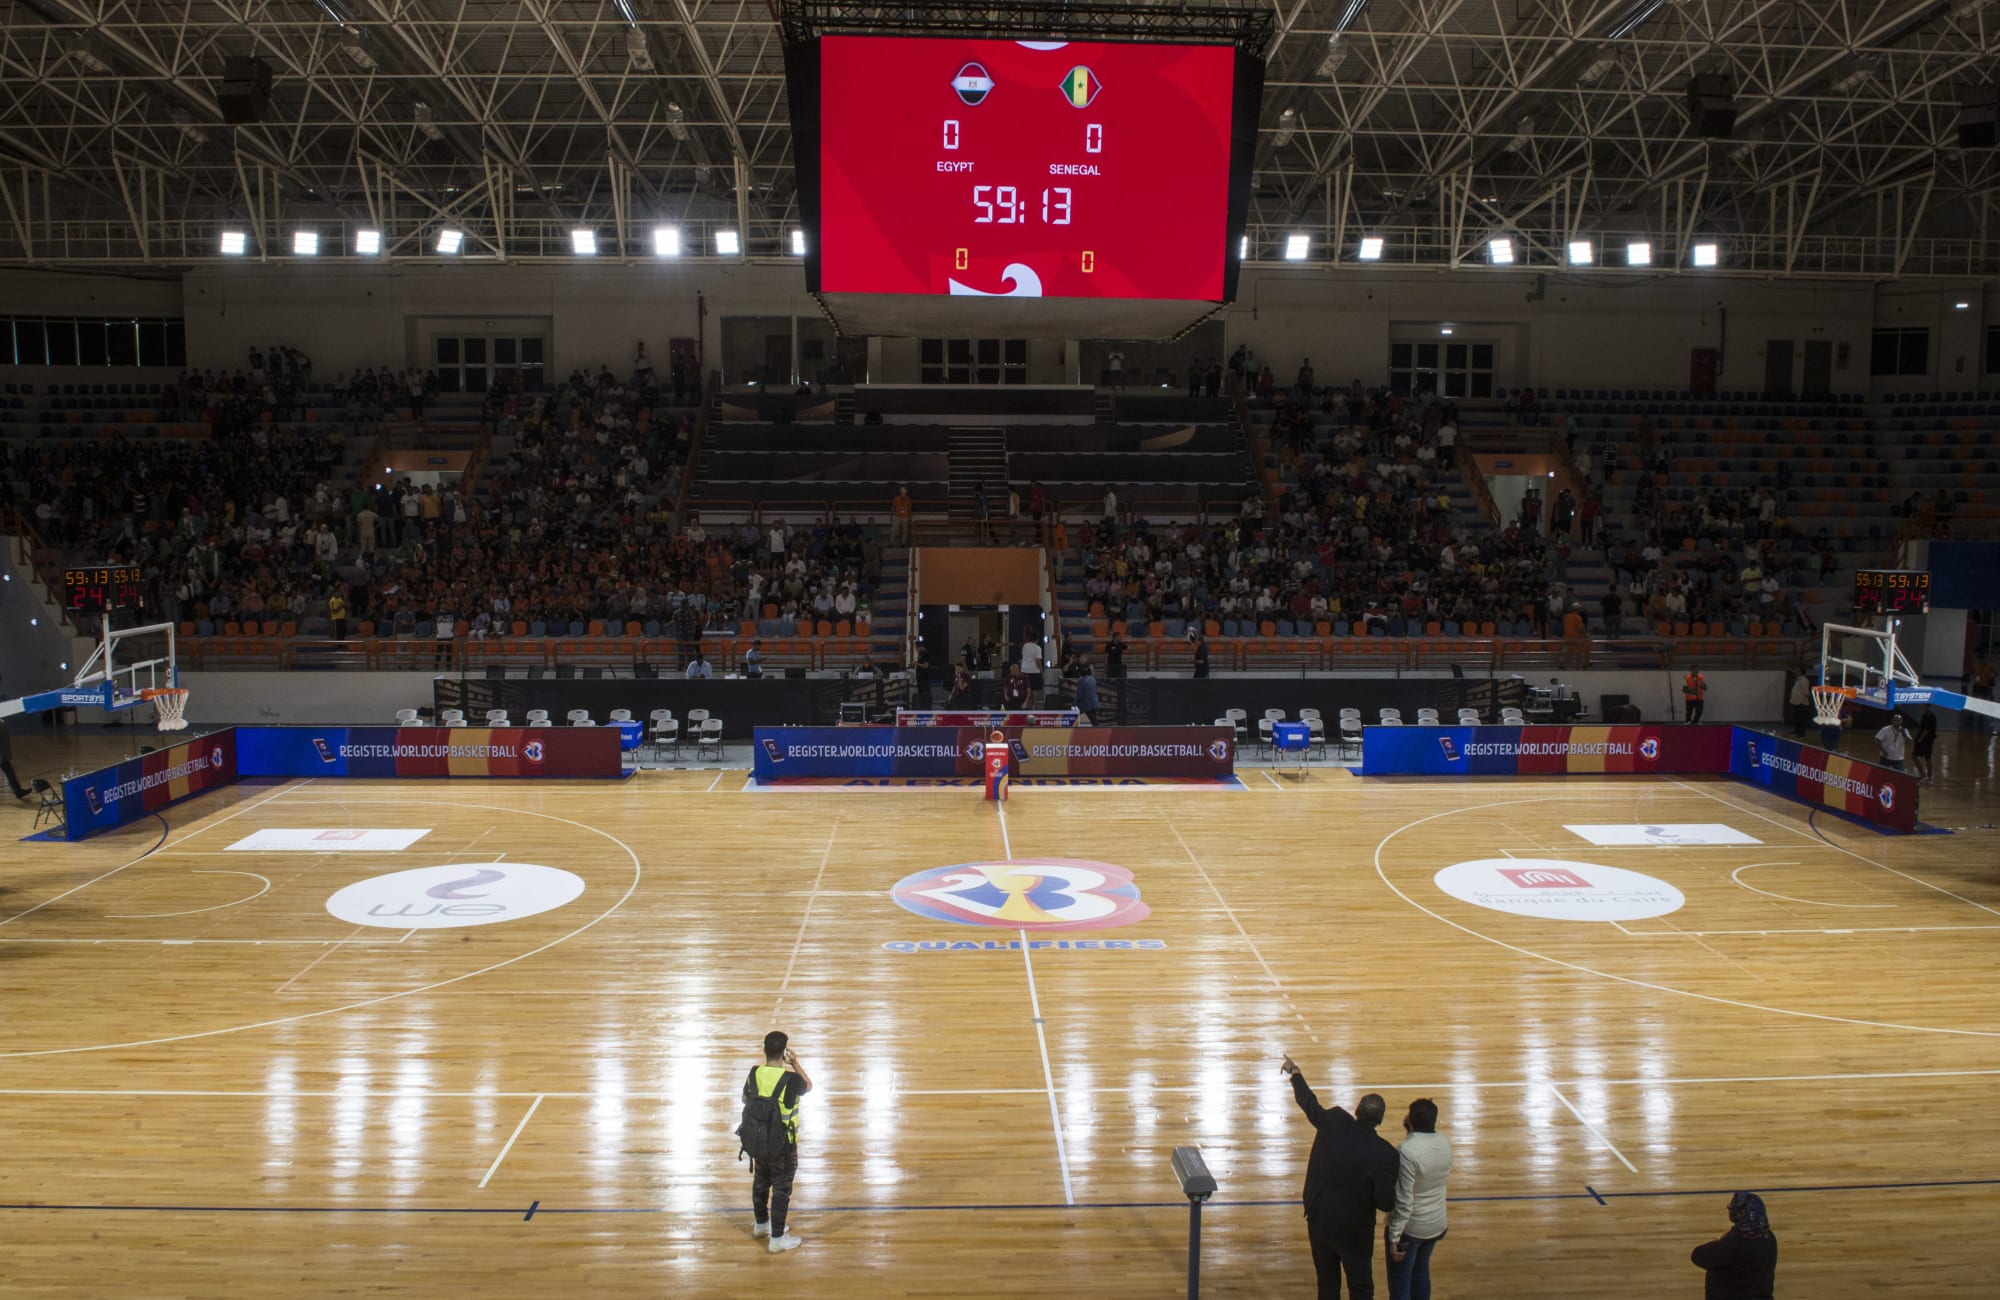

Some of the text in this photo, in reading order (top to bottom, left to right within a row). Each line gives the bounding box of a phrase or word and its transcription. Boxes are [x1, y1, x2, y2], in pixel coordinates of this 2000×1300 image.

[943, 120, 959, 149] 0
[1086, 124, 1102, 153] 0
[936, 161, 974, 172] EGYPT
[1049, 164, 1101, 175] SENEGAL
[956, 248, 968, 270] 0
[1082, 251, 1094, 272] 0
[66, 570, 108, 585] 59:13
[1889, 574, 1929, 588] 59:13
[73, 587, 102, 607] 24
[119, 585, 137, 605] 24
[1859, 588, 1879, 607] 24
[1894, 589, 1922, 609] 24
[339, 744, 519, 759] REGISTER.WORLDCUP.BASKETBALL
[788, 744, 962, 758] REGISTER.WORLDCUP.BASKETBALL
[1032, 743, 1205, 758] REGISTER.WORLDCUP.BASKETBALL
[1464, 742, 1634, 757] REGISTER.WORLDCUP.BASKETBALL
[104, 756, 209, 804] REGISTER.WORLDCUP.BASKETBALL
[1761, 752, 1875, 799] REGISTER.WORLDCUP.BASKETBALL
[882, 940, 1168, 952] QUALIFIERS
